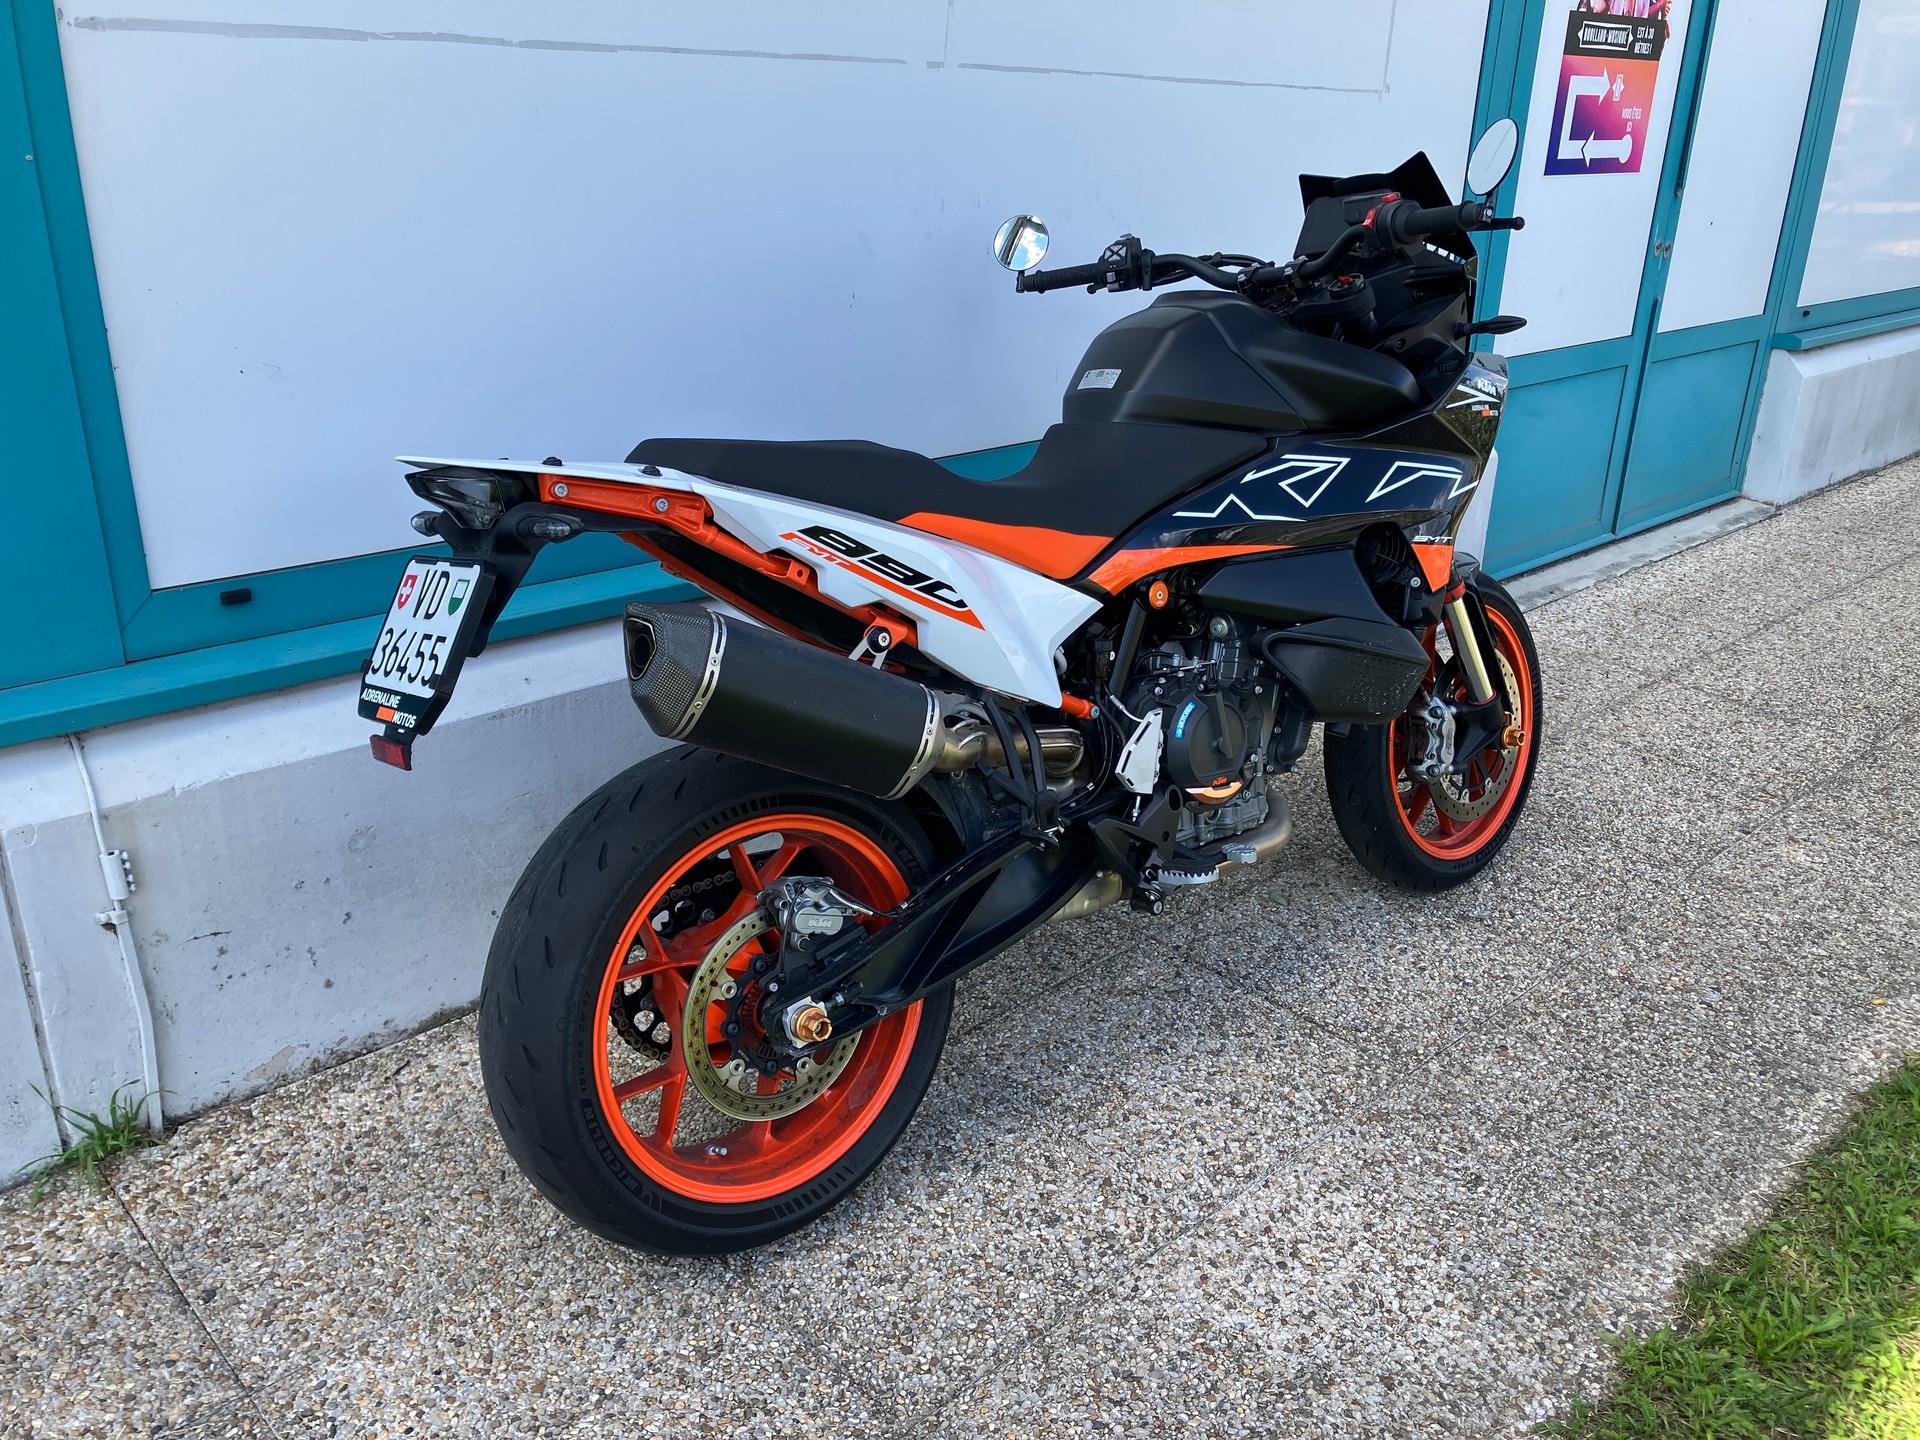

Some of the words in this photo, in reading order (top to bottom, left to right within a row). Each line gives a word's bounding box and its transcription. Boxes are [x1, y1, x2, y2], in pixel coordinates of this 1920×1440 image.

[1478, 378, 1496, 396] KTM
[1411, 535, 1453, 543] SMT
[797, 525, 969, 609] 890
[412, 569, 451, 620] VD
[371, 627, 447, 687] 36455
[360, 688, 401, 709] ADRENALINE
[392, 710, 417, 728] MOTOS
[1212, 777, 1227, 786] KTM
[807, 918, 832, 929] KTM
[578, 1039, 588, 1093] 180/55
[583, 1107, 639, 1190] MICHELIN
